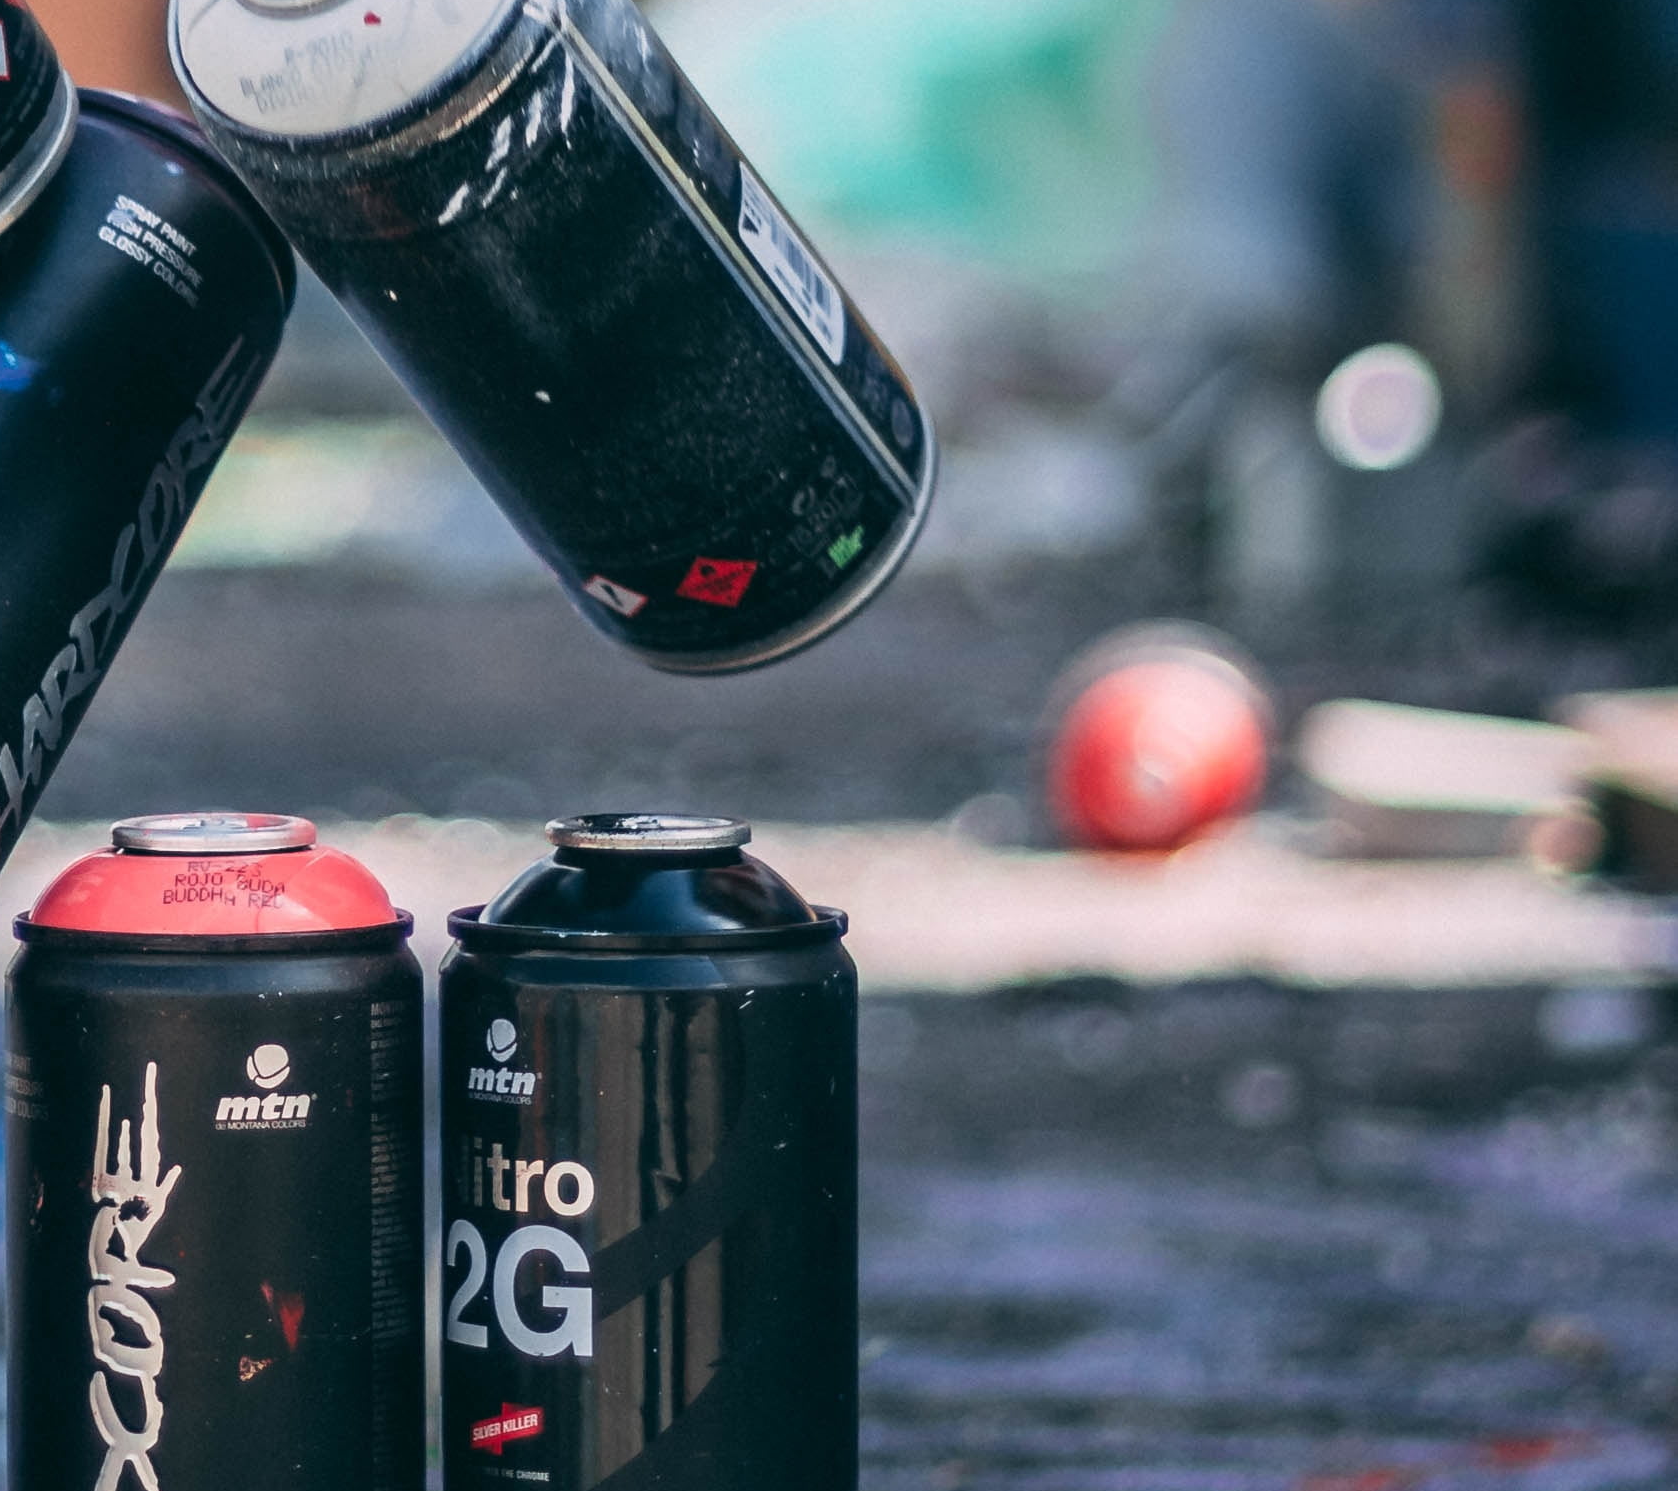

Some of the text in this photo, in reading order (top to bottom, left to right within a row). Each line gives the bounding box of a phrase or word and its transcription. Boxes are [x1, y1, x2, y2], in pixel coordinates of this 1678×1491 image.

[113, 193, 197, 256] SPRAY PAINT
[97, 224, 200, 307] GLOSSY COLORS
[141, 230, 204, 288] PRESSURE
[175, 872, 223, 886] ROJO
[163, 887, 236, 906] BUDDHA
[468, 1067, 536, 1095] mtn
[216, 1093, 311, 1121] mtn
[503, 1095, 532, 1105] COLORS
[227, 1121, 270, 1130] MONTANA
[271, 1119, 306, 1129] COLORS
[466, 1135, 594, 1216] itro
[447, 1219, 593, 1357] 2G
[473, 1414, 538, 1441] SILVER KILLER
[516, 1470, 550, 1482] CHROME
